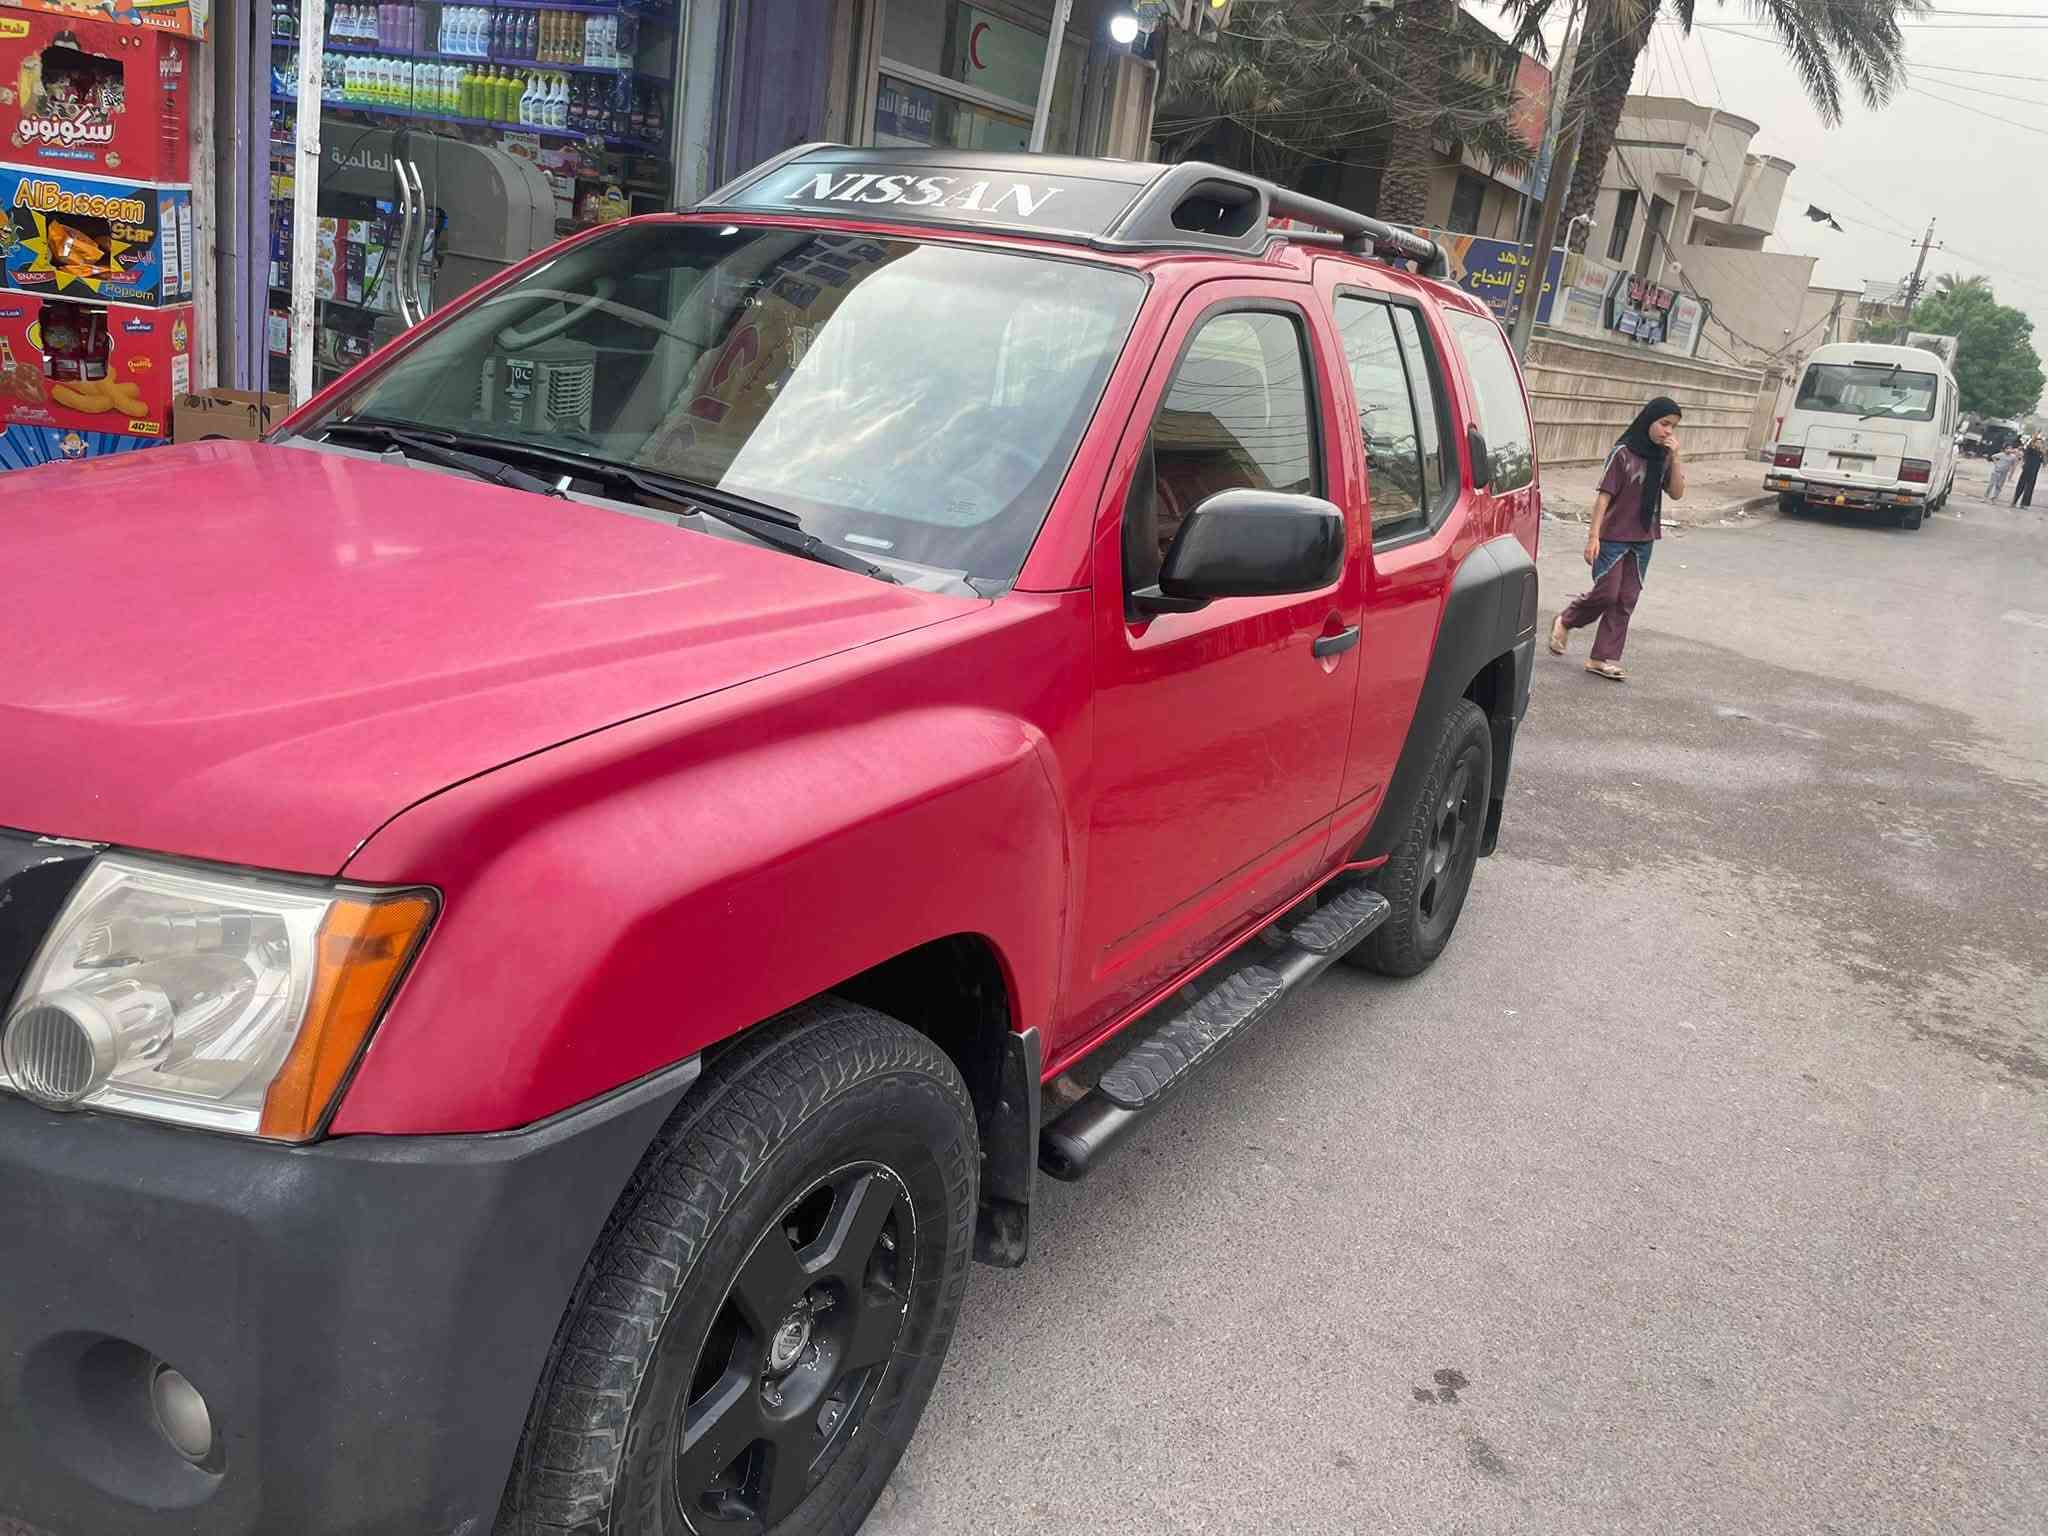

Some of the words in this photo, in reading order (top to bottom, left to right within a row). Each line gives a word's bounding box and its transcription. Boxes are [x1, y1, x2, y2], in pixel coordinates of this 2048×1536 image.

[18, 107, 113, 145] سكونونو
[331, 146, 393, 173] العالمية
[784, 172, 1064, 217] NISSAN
[111, 222, 154, 243] Star
[1471, 267, 1512, 289] النجاح
[104, 283, 154, 301] Popcorn
[131, 421, 145, 431] 40
